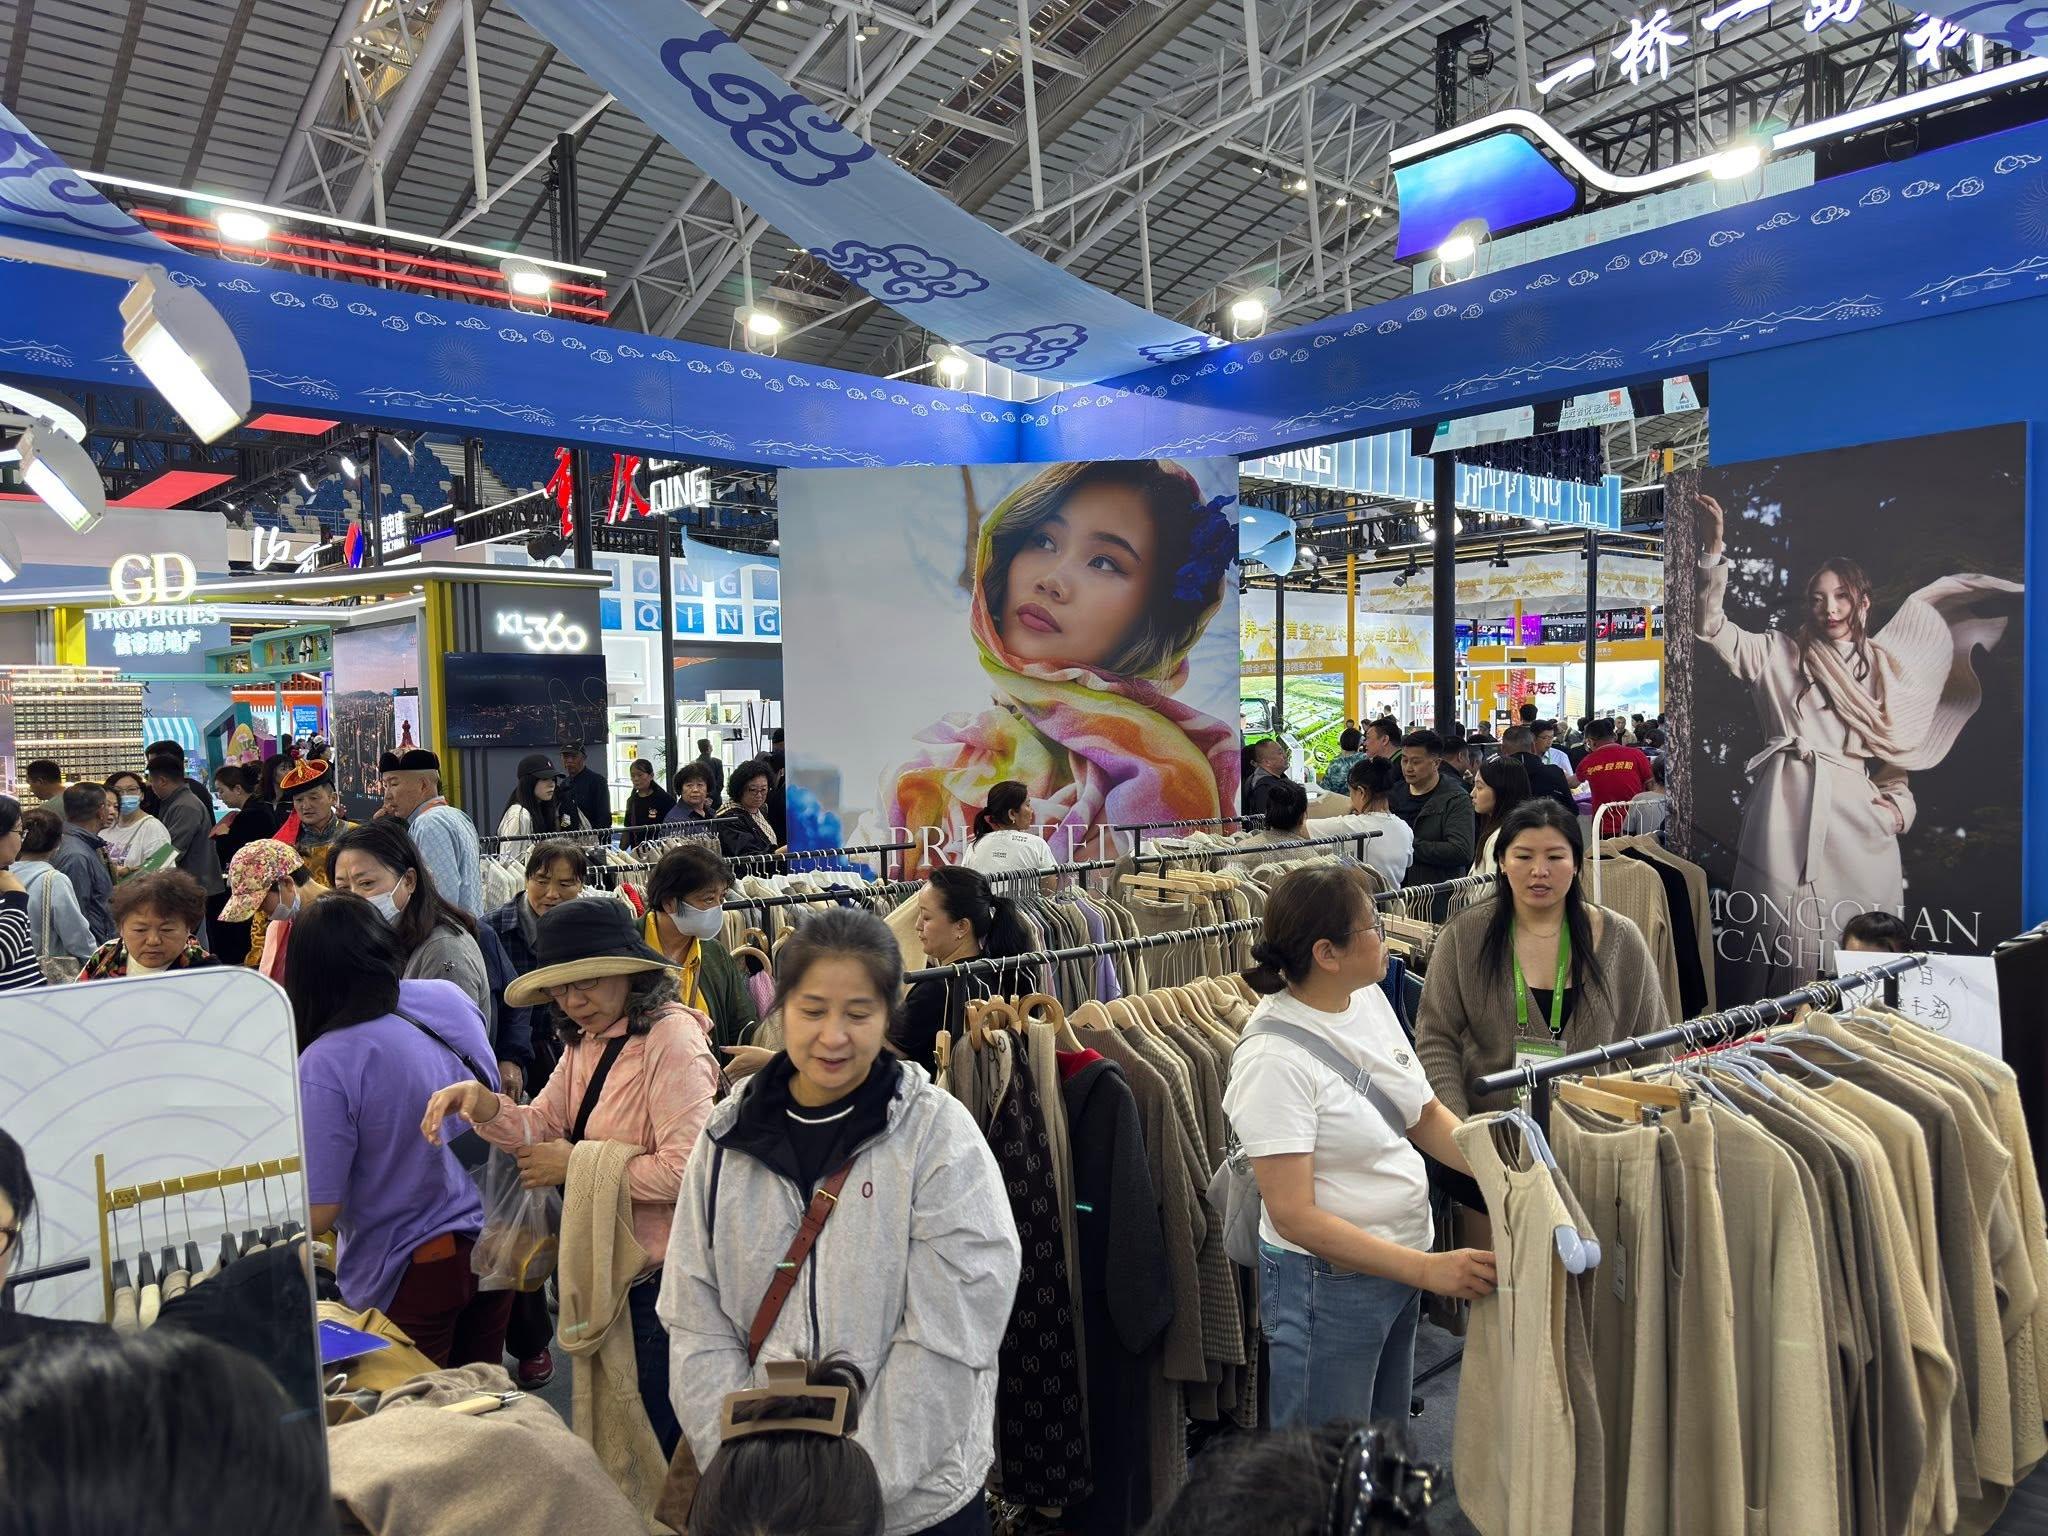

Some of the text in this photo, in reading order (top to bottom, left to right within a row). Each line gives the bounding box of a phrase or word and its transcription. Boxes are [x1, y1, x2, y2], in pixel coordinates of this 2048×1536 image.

[650, 466, 711, 515] QING
[110, 552, 197, 606] GD
[92, 604, 220, 630] PROPERTIES
[496, 611, 588, 651] KL360
